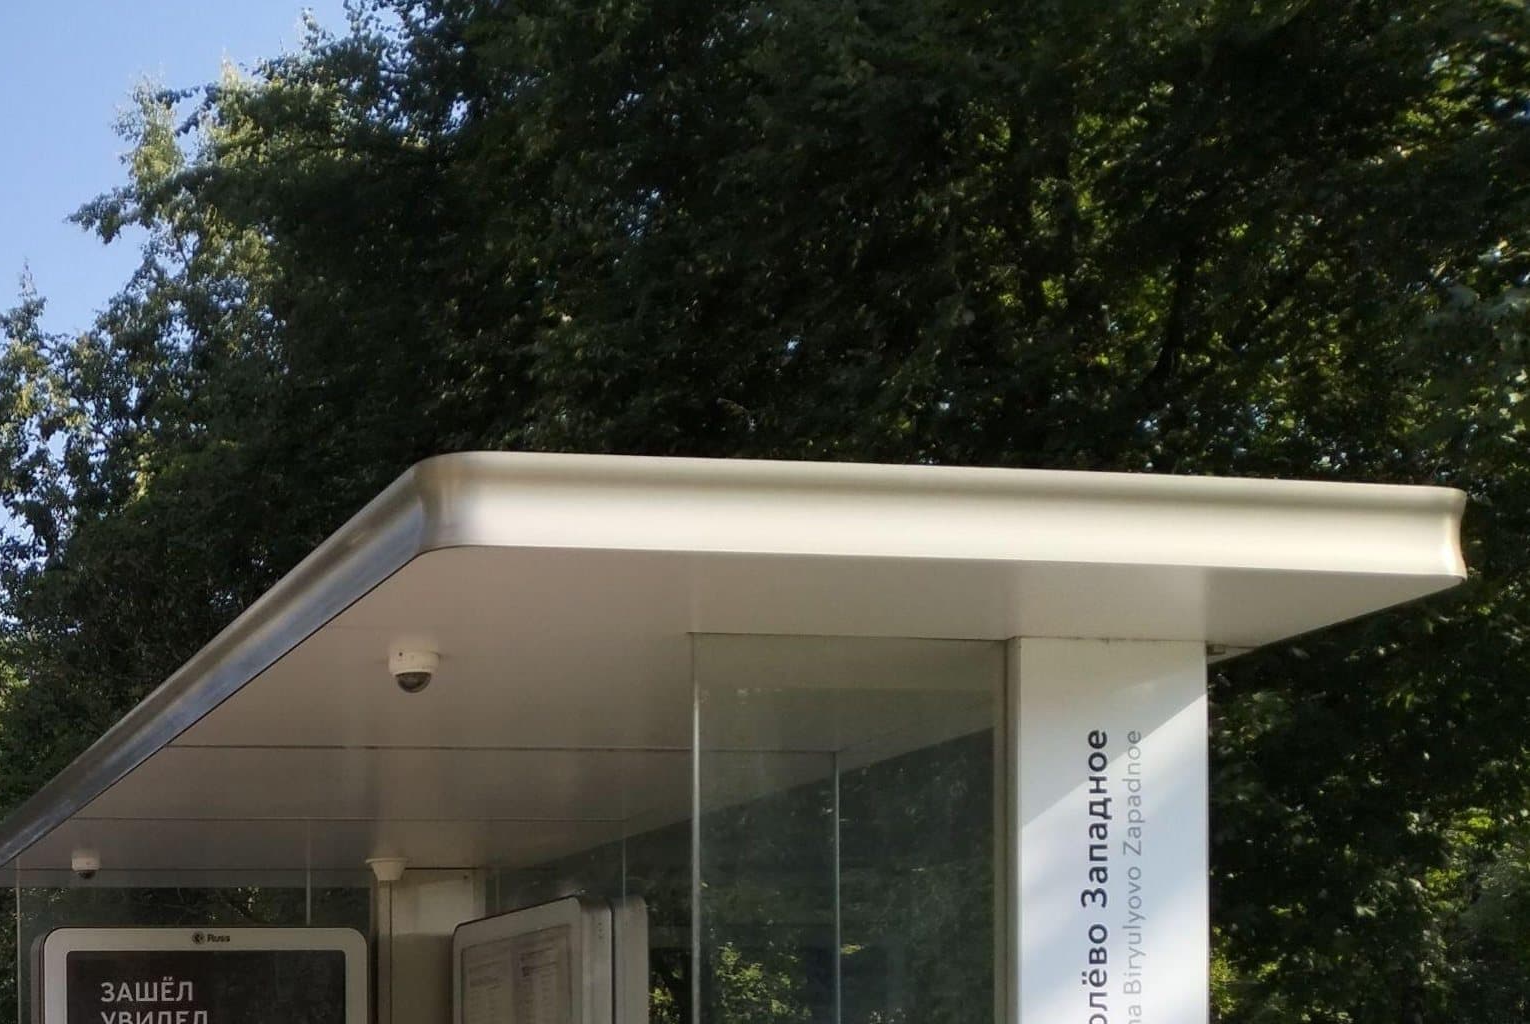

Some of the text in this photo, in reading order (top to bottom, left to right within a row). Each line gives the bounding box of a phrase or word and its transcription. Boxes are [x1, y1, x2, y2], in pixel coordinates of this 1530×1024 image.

[1081, 730, 1113, 908] Западное
[1122, 730, 1146, 856] Zapadnoe
[101, 976, 193, 1002] ЗАШЁЛ
[1122, 866, 1146, 994] Biryulyovo
